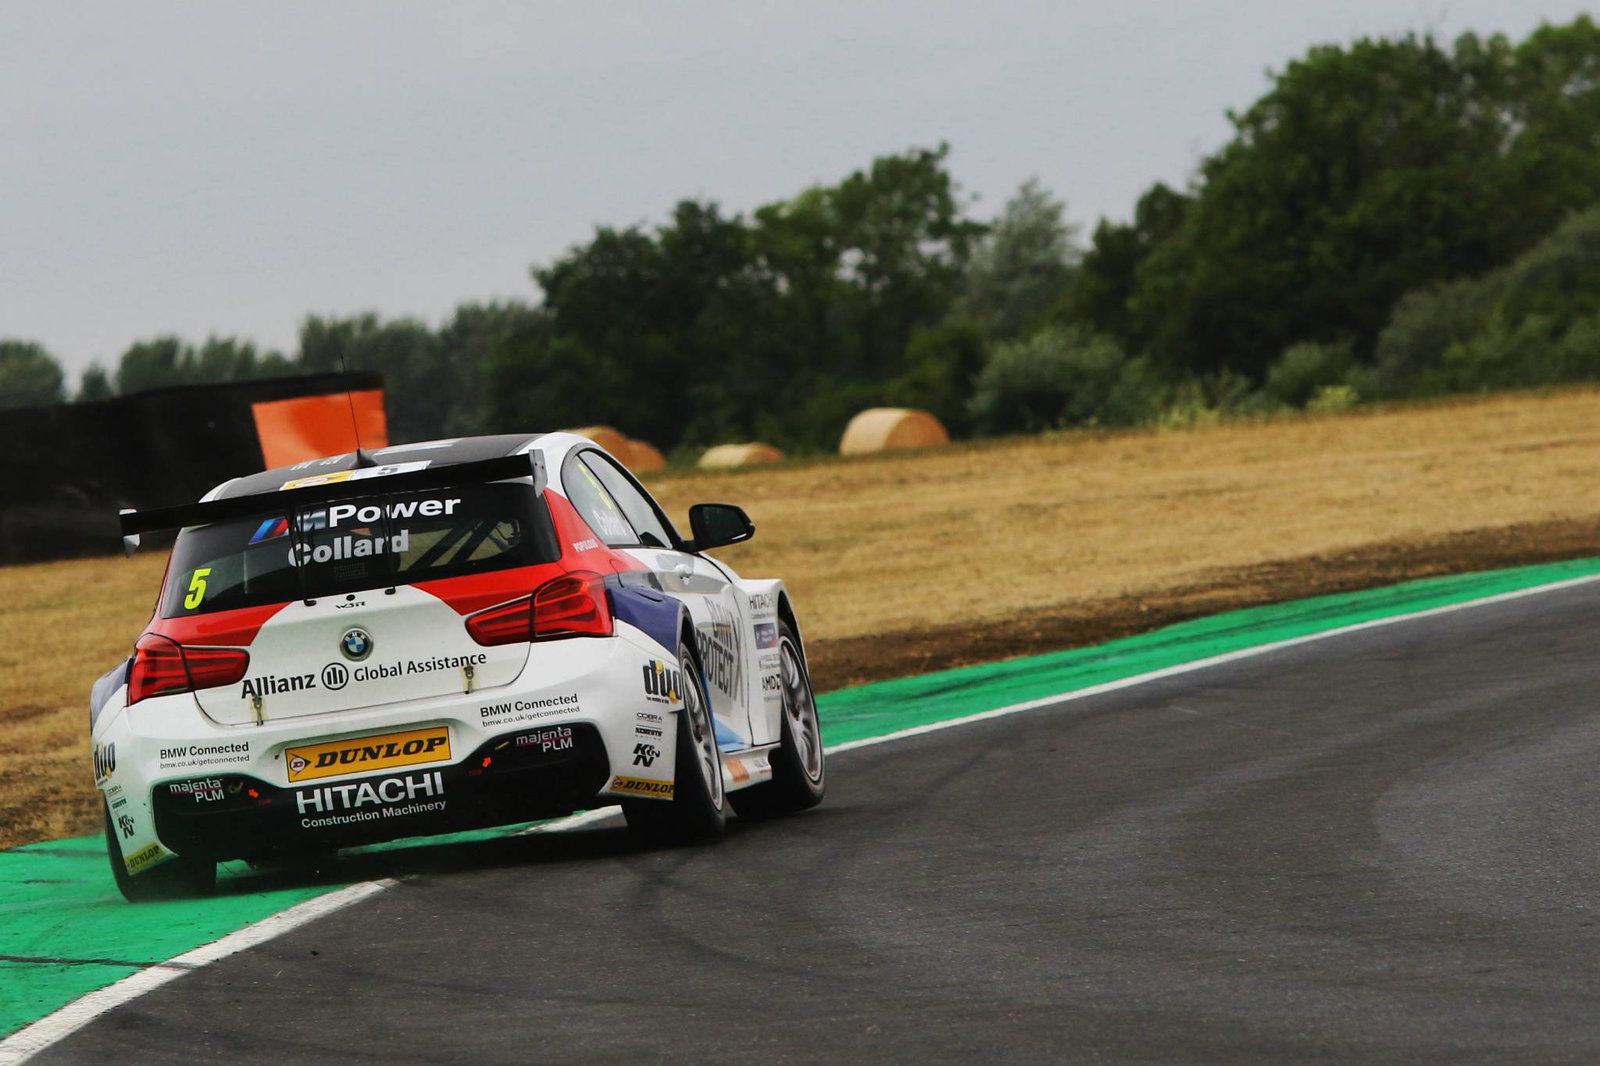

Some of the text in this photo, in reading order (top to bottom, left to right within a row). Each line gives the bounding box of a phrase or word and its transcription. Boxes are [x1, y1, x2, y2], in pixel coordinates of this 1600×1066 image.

[288, 529, 409, 567] Collard
[184, 568, 211, 610] 5
[241, 653, 487, 699] Allianz Global Assistance
[480, 693, 578, 718] BMW Connected
[482, 706, 580, 728] bmw.co.uk/getconnected
[516, 727, 572, 745] majenta
[542, 738, 573, 752] PLM
[160, 741, 250, 759] BMW Connected
[315, 736, 447, 768] DUNLOP
[160, 755, 250, 769] bmw.co.uk/getconnected
[170, 779, 222, 793] majenta
[195, 789, 225, 802] PLM
[296, 771, 444, 814] HITACHI
[301, 800, 446, 828] Construction Machinery
[130, 845, 160, 868] DUNLOP
